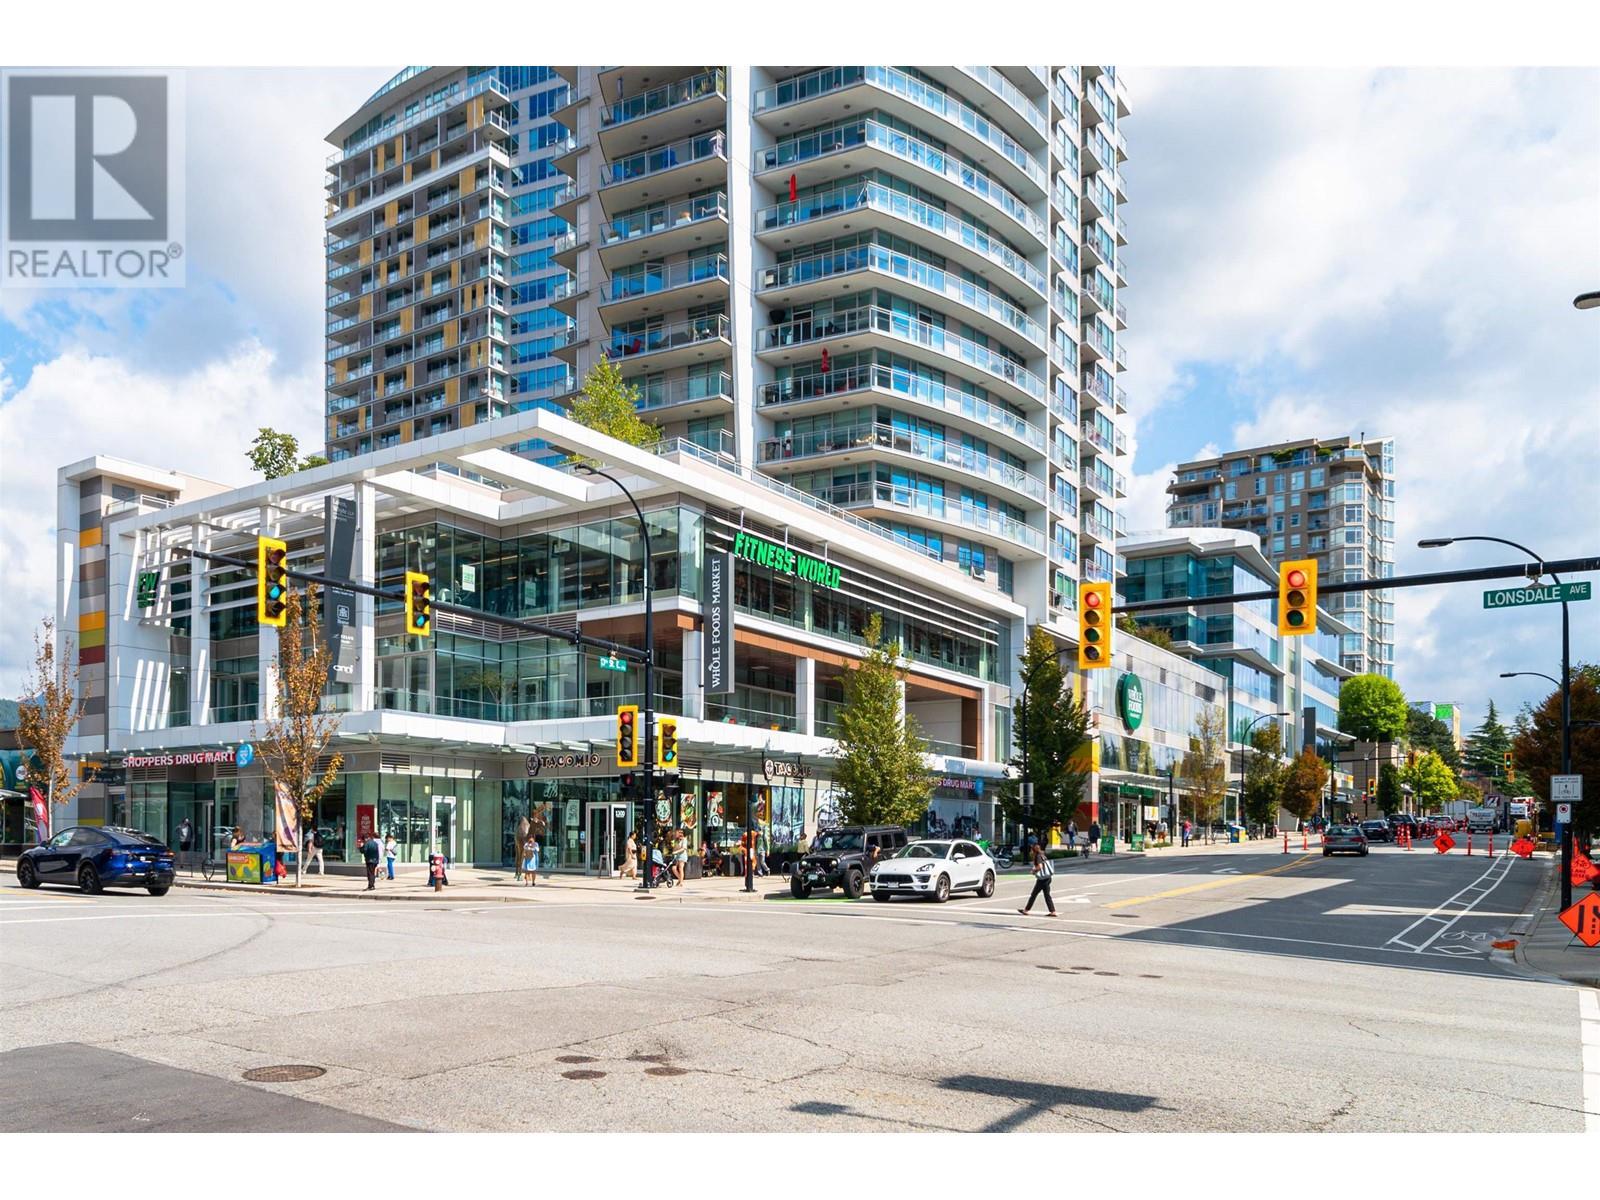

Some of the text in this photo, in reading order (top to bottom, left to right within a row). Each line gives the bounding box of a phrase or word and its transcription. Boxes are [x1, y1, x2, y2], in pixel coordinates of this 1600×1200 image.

[735, 532, 841, 590] FITNESS WORLD
[1487, 584, 1587, 606] LONSDALE AVE
[712, 559, 721, 688] WHOLE FOODS MARKET
[122, 755, 174, 768] SHOPPERS
[175, 752, 204, 765] DRUG
[205, 751, 236, 763] MART
[942, 778, 960, 788] DRUG
